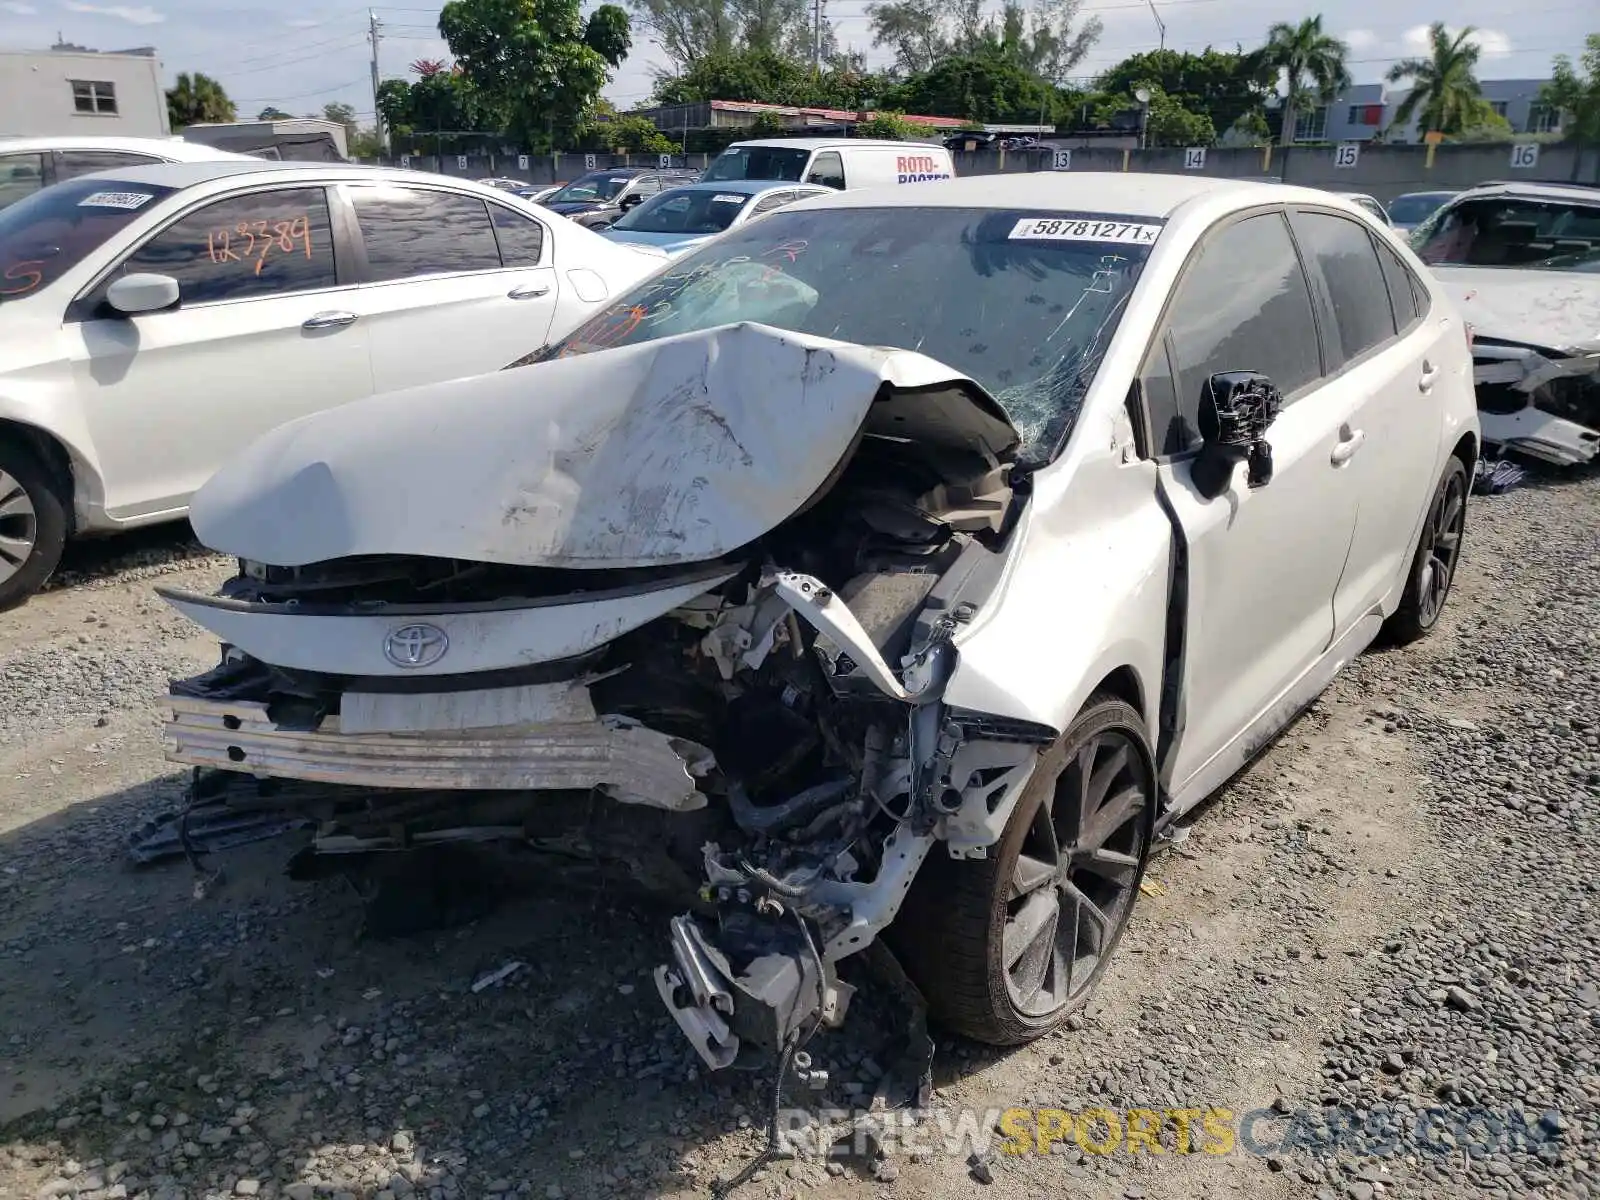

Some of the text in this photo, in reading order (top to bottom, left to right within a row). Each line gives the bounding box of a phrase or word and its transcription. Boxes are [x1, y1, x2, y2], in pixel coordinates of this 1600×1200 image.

[1054, 152, 1068, 168] 13
[1186, 151, 1203, 167] 14
[1337, 148, 1356, 165] 15
[1514, 147, 1535, 166] 16
[896, 157, 938, 173] ROTO-
